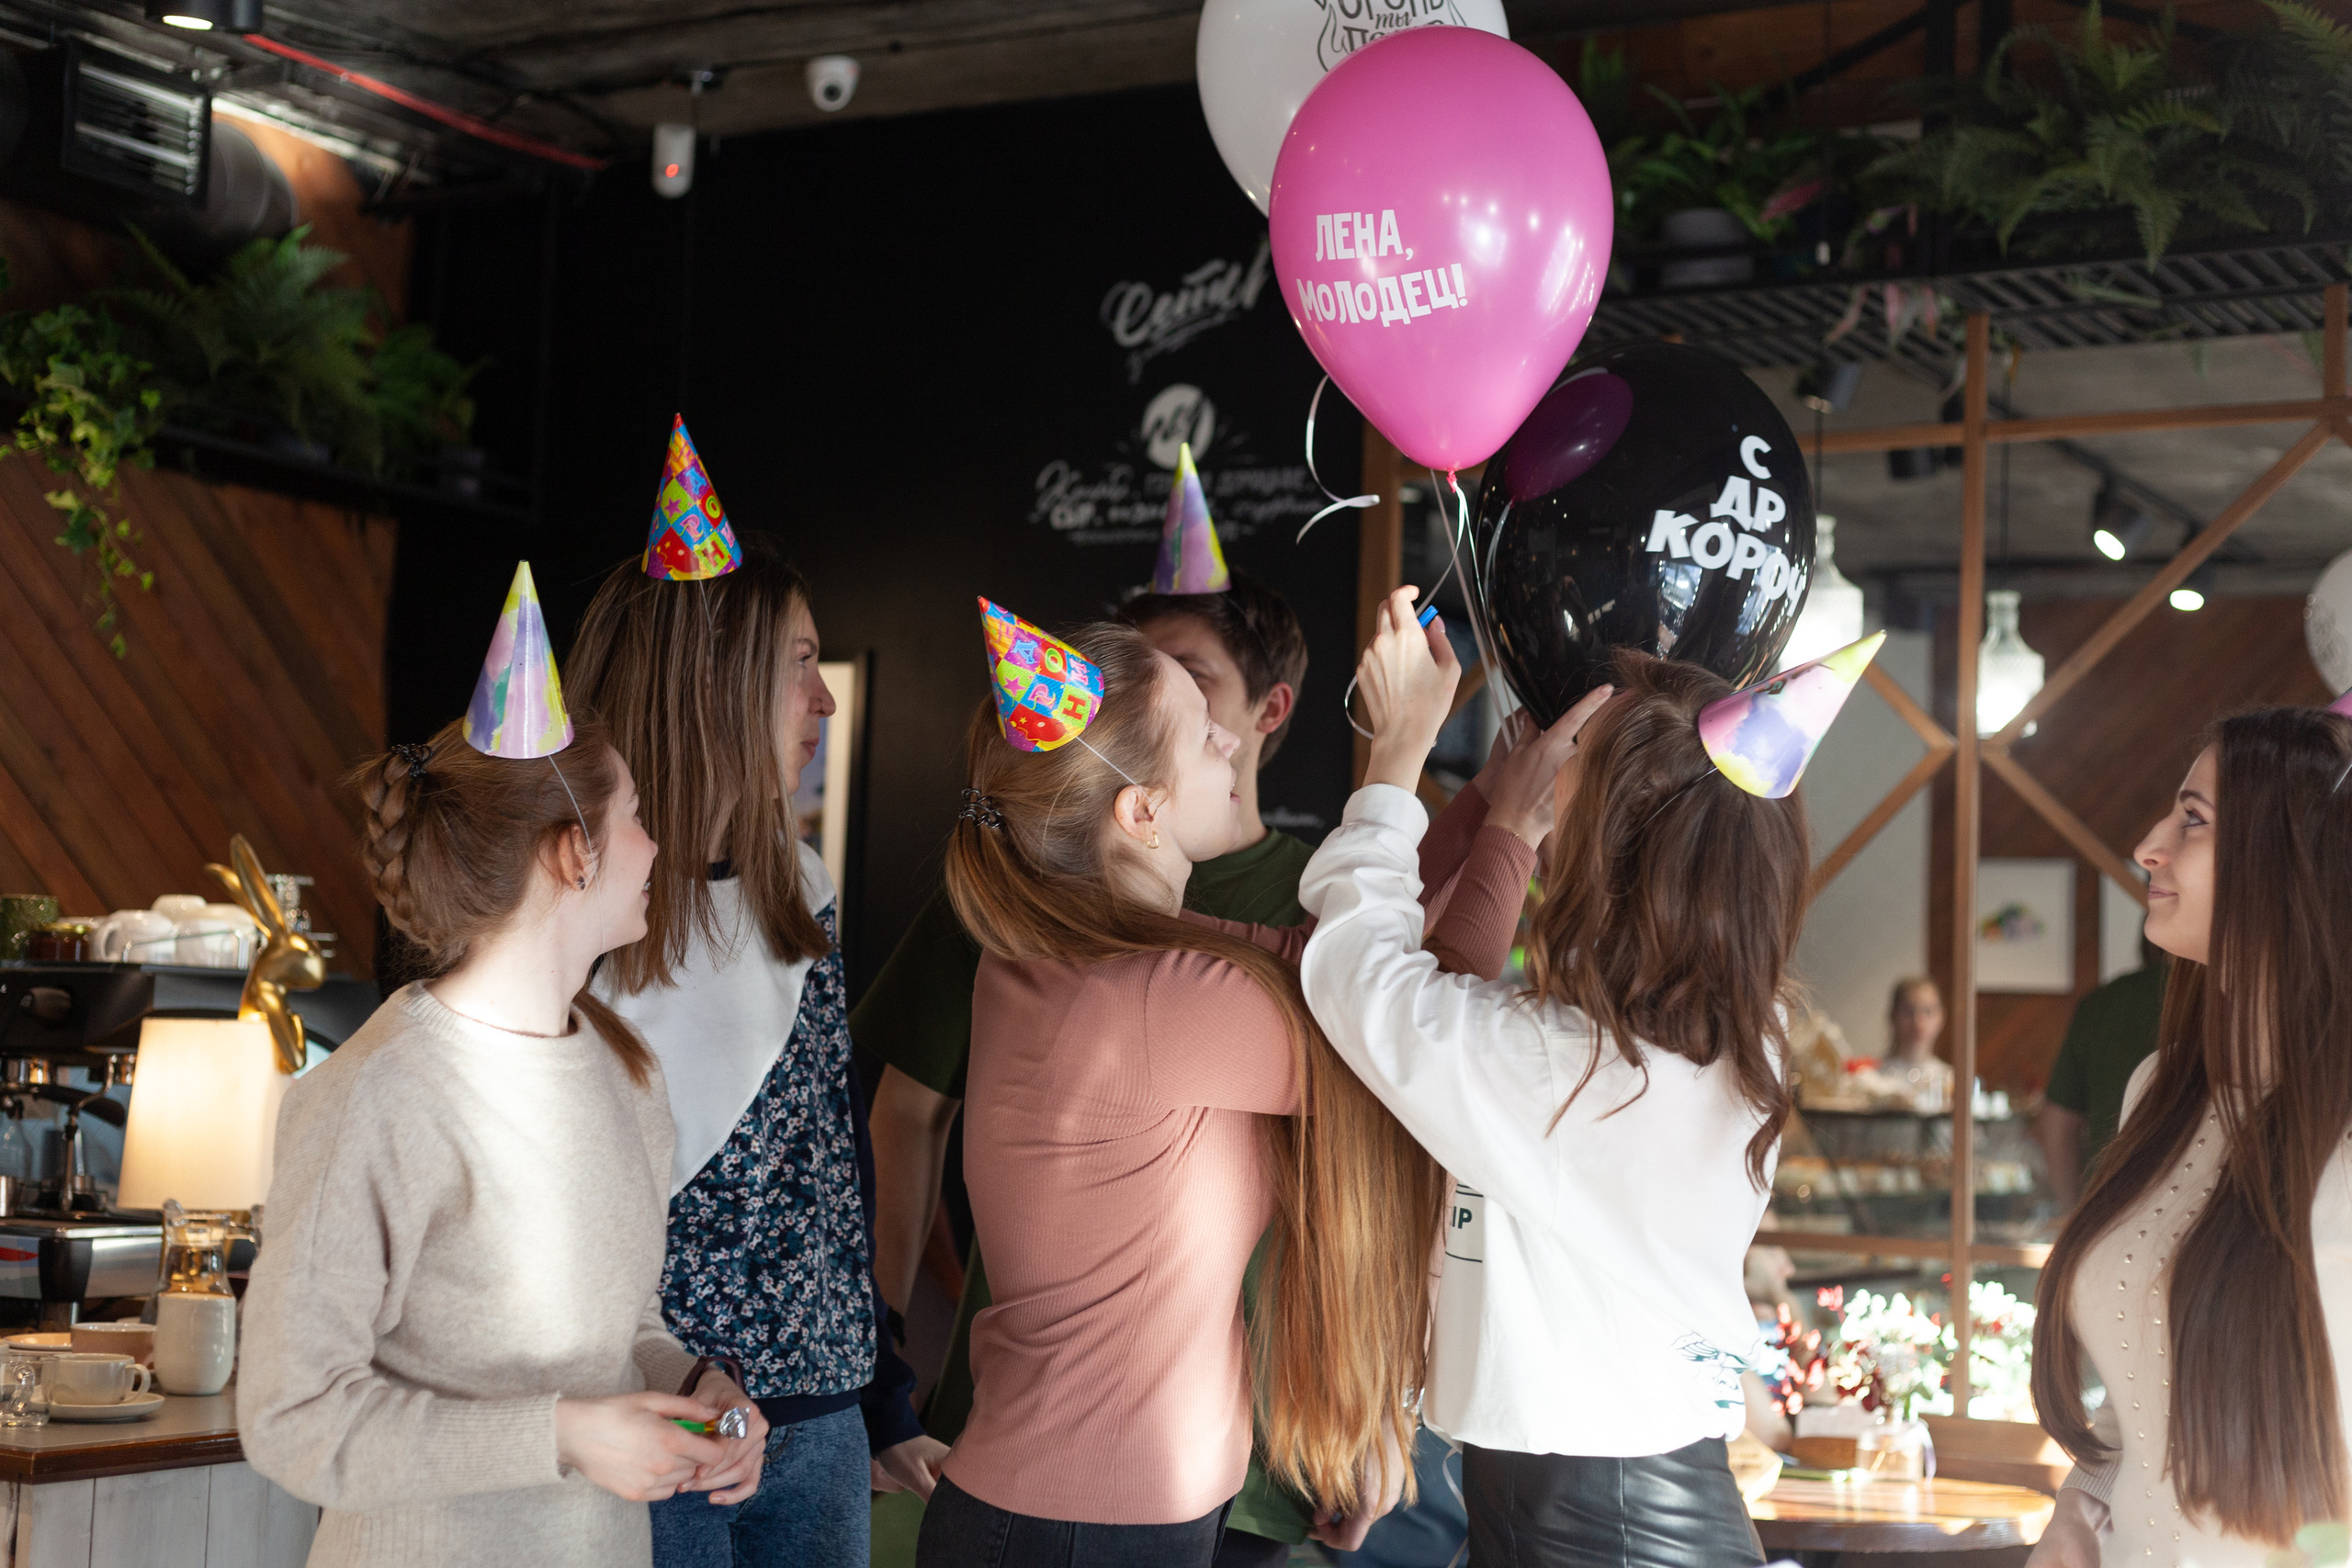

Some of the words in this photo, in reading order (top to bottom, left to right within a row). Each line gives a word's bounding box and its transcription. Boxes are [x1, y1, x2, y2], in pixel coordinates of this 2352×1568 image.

[1315, 209, 1414, 262] ЛЕНА,
[1295, 263, 1468, 328] МОЛОДЕЦ!
[1739, 434, 1772, 480] С
